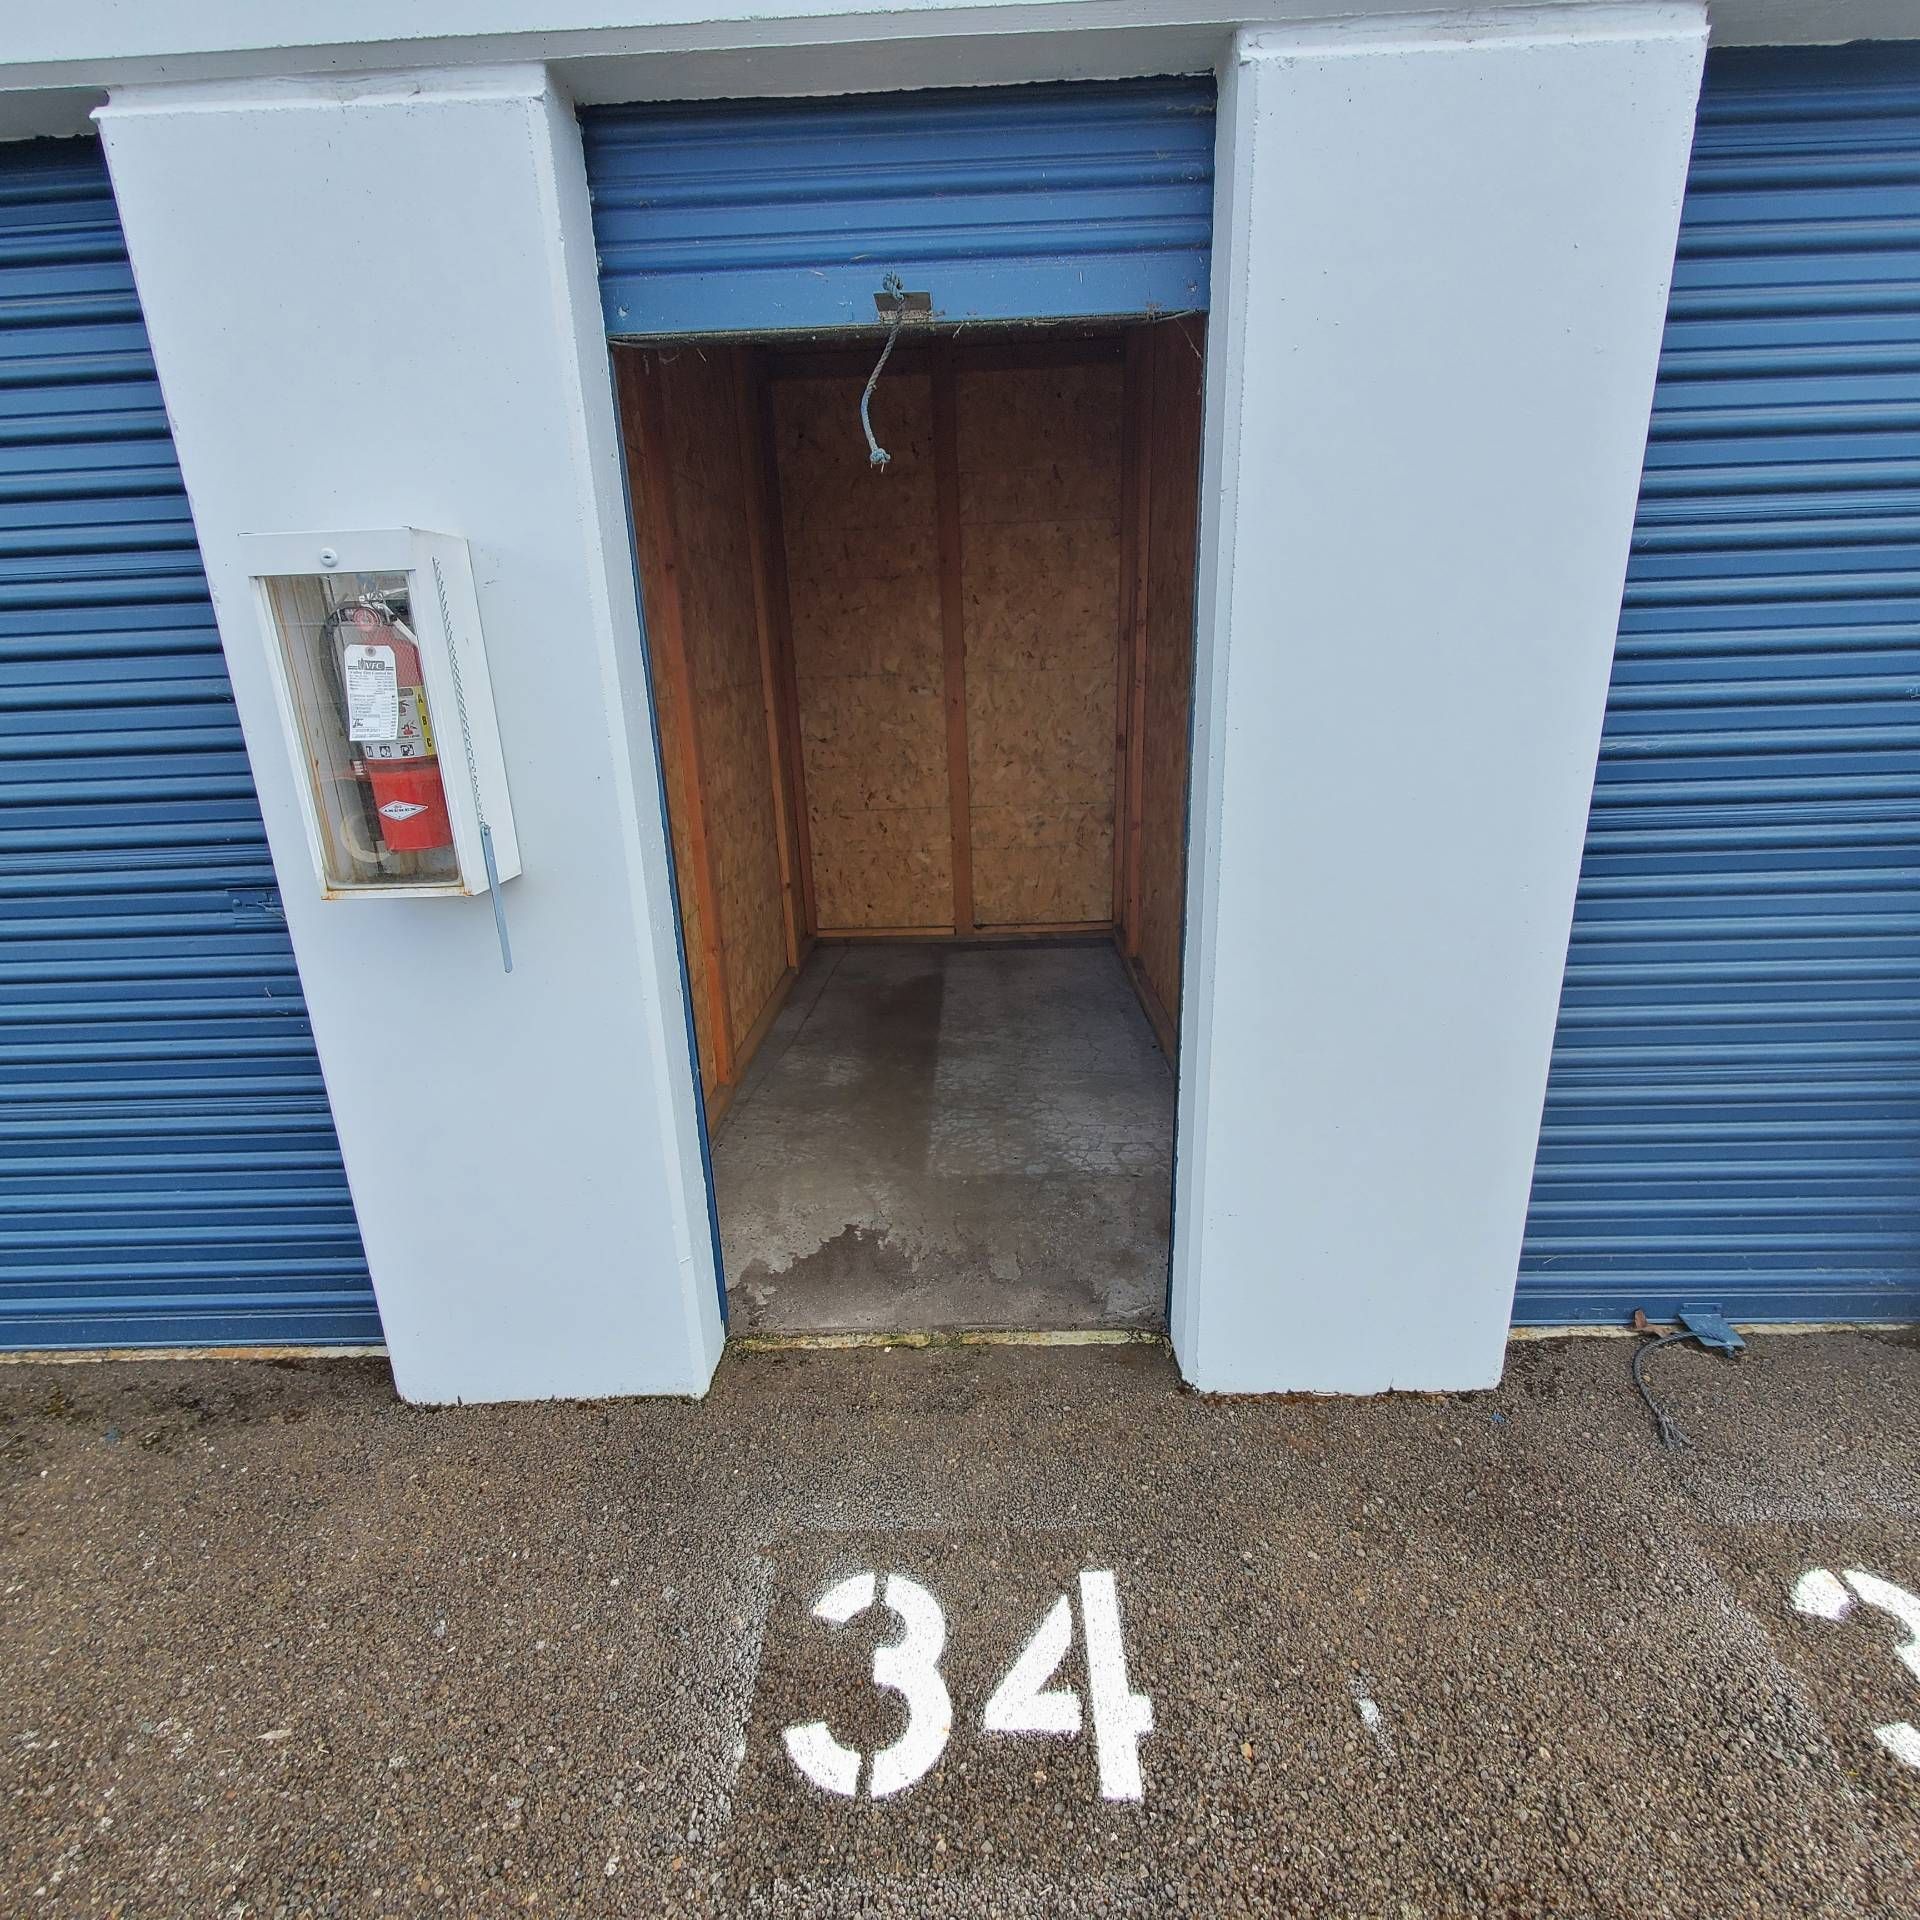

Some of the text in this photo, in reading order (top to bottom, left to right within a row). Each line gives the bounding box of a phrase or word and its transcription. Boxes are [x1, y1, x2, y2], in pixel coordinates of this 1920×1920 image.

[417, 693, 424, 704] A
[421, 715, 428, 726] B
[426, 737, 433, 748] C
[782, 1570, 1155, 1800] 34
